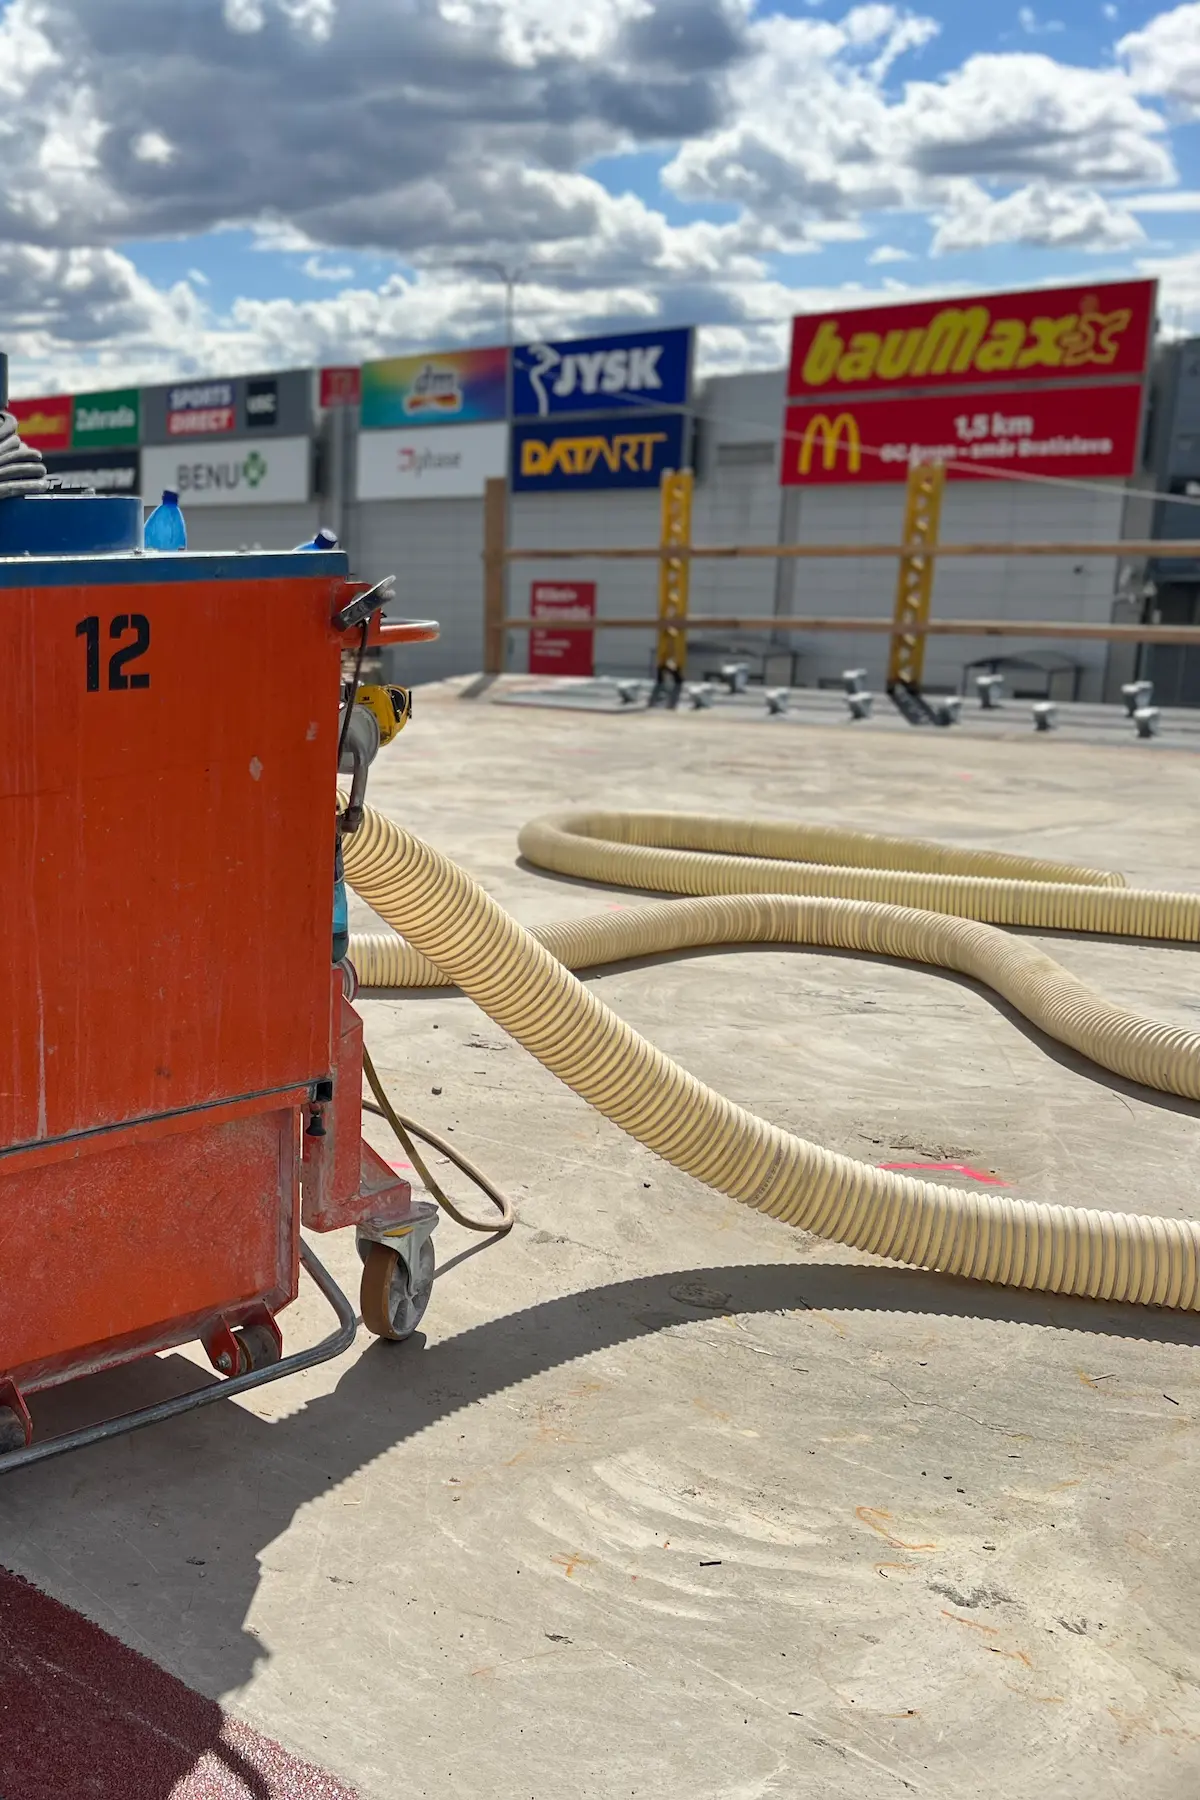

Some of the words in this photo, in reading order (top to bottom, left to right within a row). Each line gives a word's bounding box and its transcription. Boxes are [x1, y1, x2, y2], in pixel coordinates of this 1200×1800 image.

[802, 305, 1079, 386] bauMax
[414, 365, 458, 394] dm
[551, 346, 665, 397] JYSK
[169, 384, 232, 407] SPORTS
[169, 408, 233, 433] DIRECT
[991, 411, 1034, 437] km
[519, 432, 668, 476] DATART
[177, 465, 240, 491] BENU
[75, 613, 150, 692] 12
